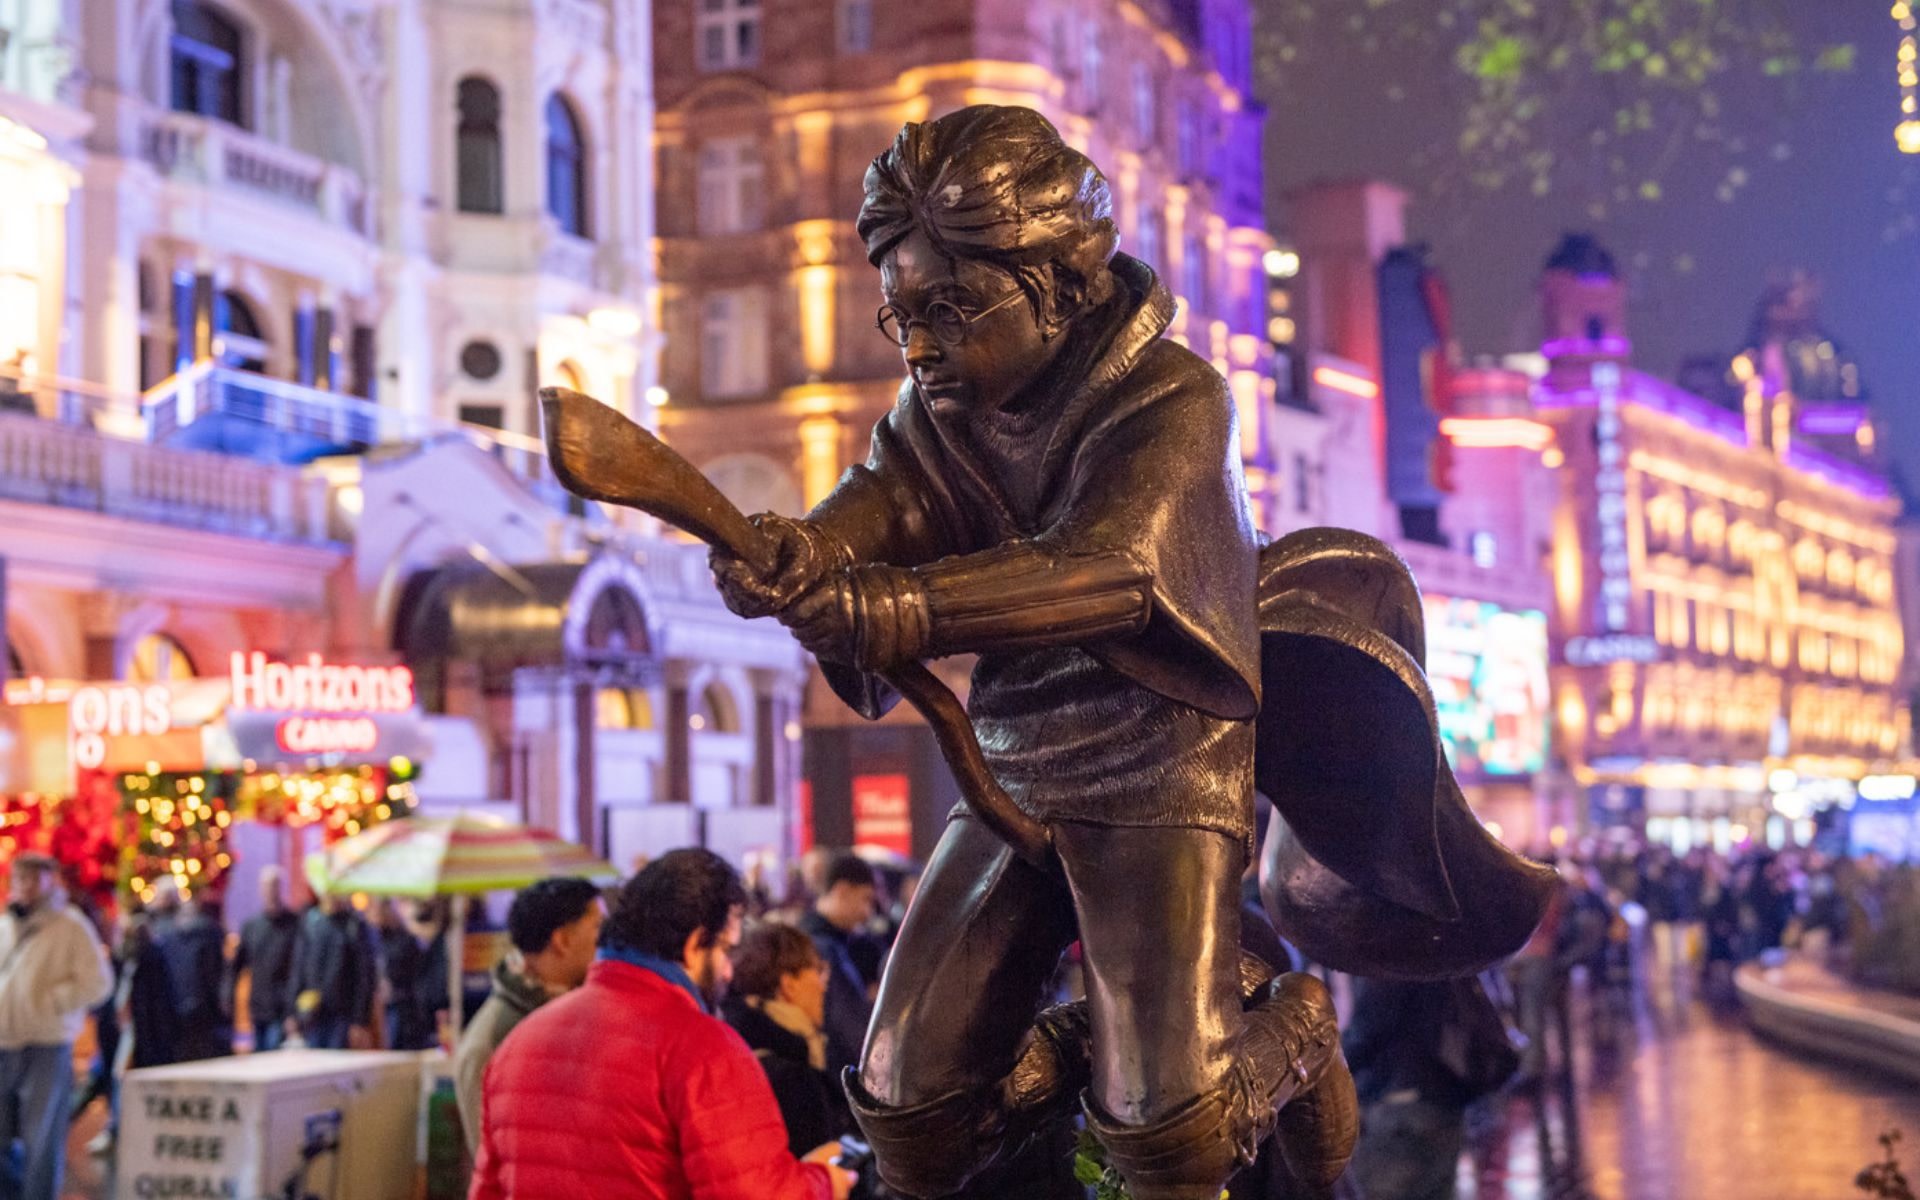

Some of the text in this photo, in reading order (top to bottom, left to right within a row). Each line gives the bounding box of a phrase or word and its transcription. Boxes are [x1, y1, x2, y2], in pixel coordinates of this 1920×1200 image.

[231, 650, 414, 711] Horizons
[71, 685, 171, 736] ons
[146, 1096, 240, 1121] TAKE A
[155, 1134, 222, 1160] FREE
[134, 1173, 238, 1199] QURAN
